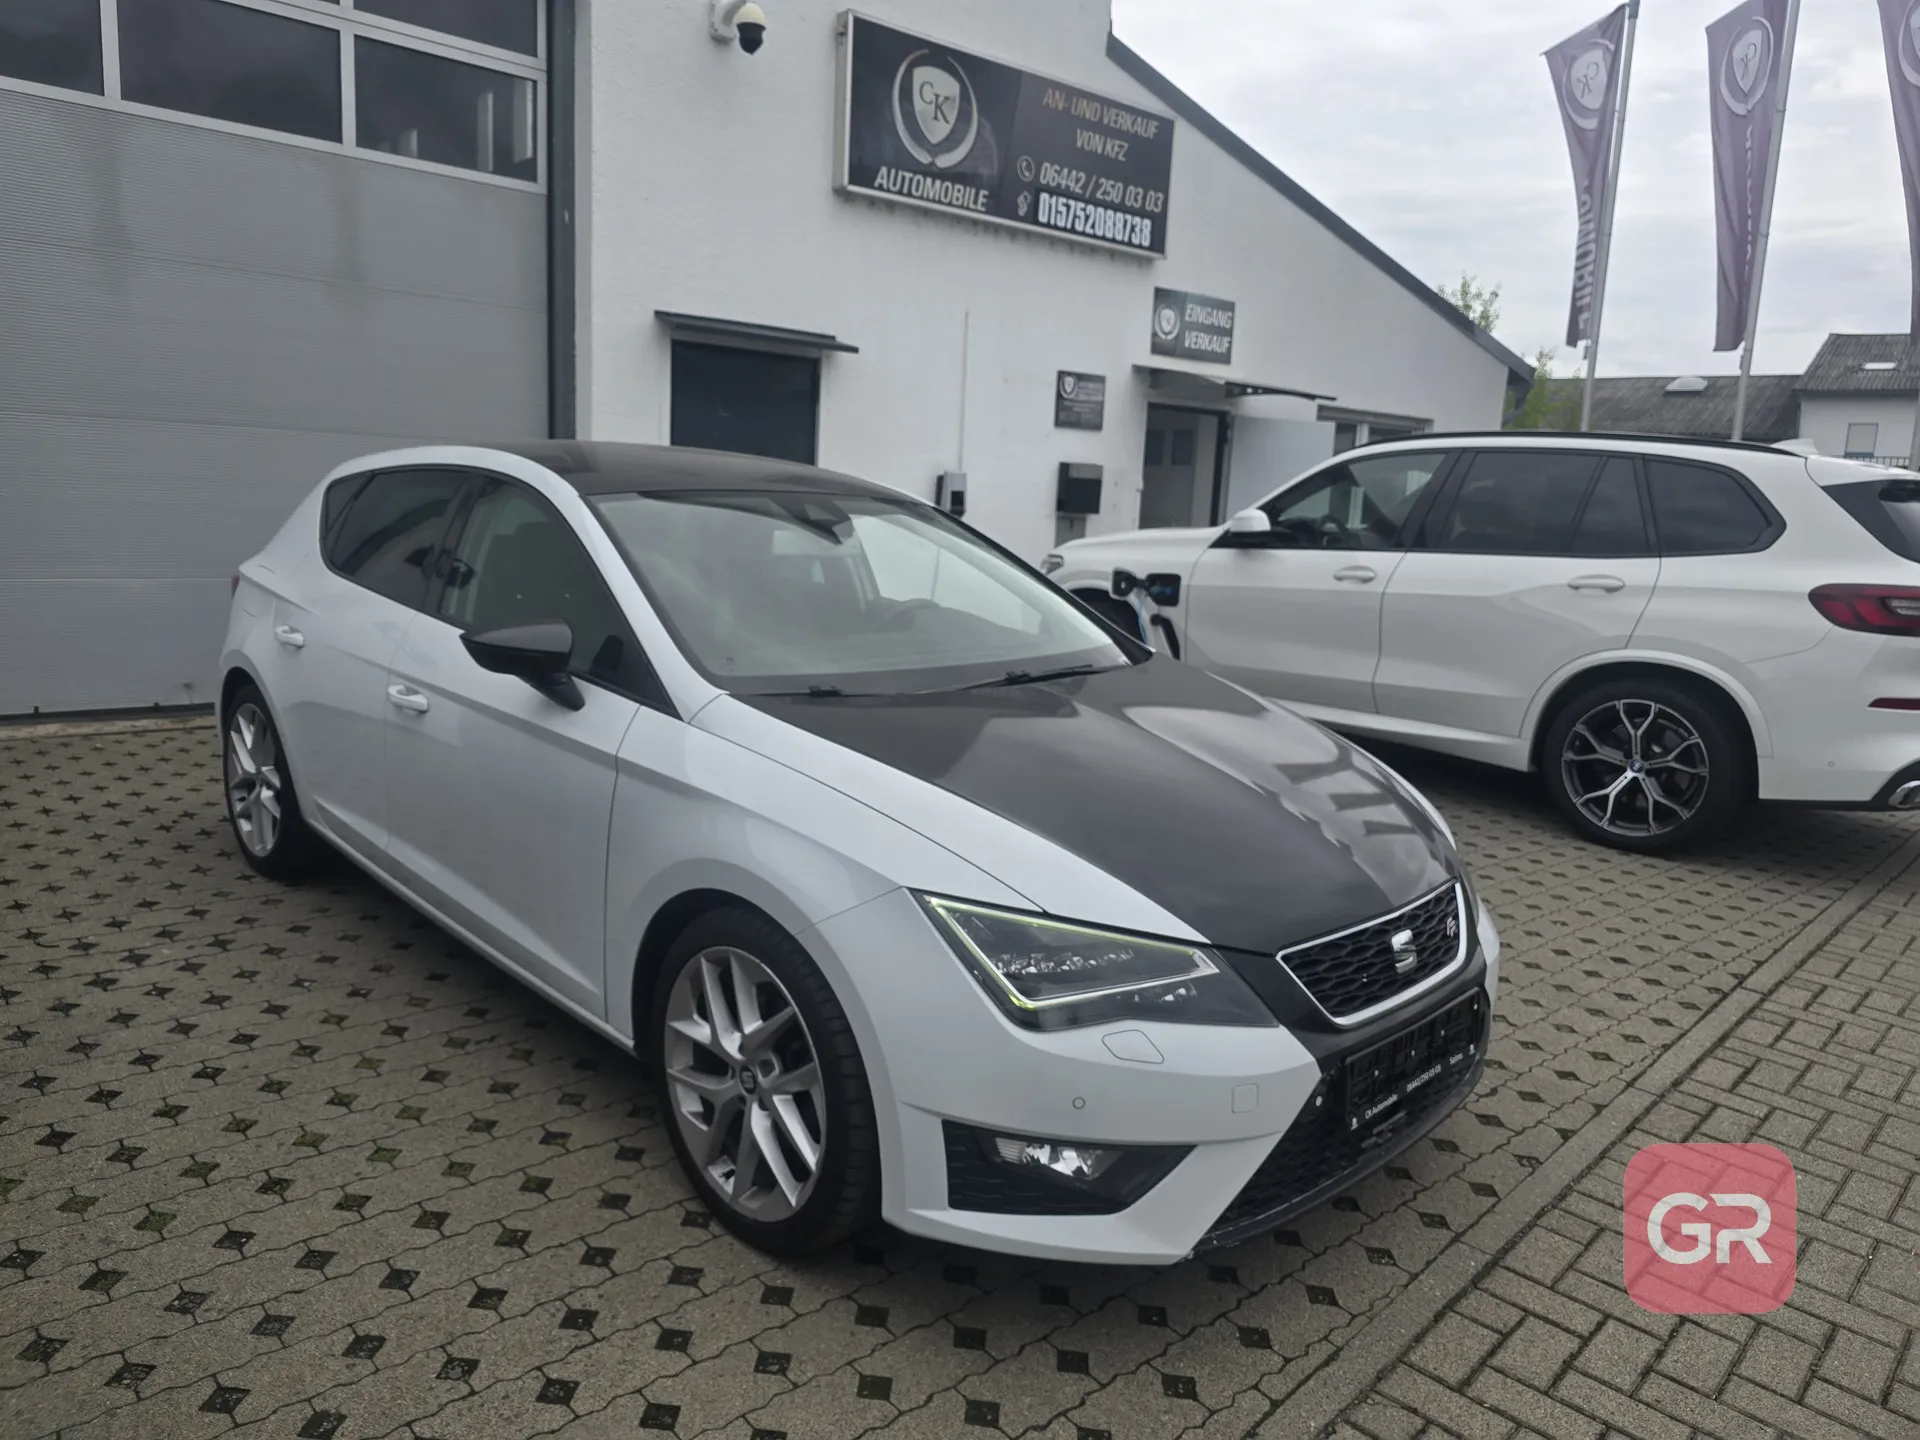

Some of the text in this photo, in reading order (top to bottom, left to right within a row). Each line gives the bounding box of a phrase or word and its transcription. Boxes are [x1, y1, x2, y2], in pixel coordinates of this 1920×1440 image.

[919, 81, 951, 125] CK
[1042, 88, 1160, 139] AN- UND VERKAUF
[1076, 128, 1129, 162] VON KFZ
[874, 165, 989, 212] AUTOMOBILE
[1040, 161, 1086, 194] 06442
[1096, 176, 1123, 204] 250
[1125, 184, 1143, 209] 03
[1145, 190, 1164, 213] 03
[1038, 192, 1152, 248] 015752088738
[1185, 303, 1233, 329] EINGANG
[1184, 330, 1232, 354] VERKAUF
